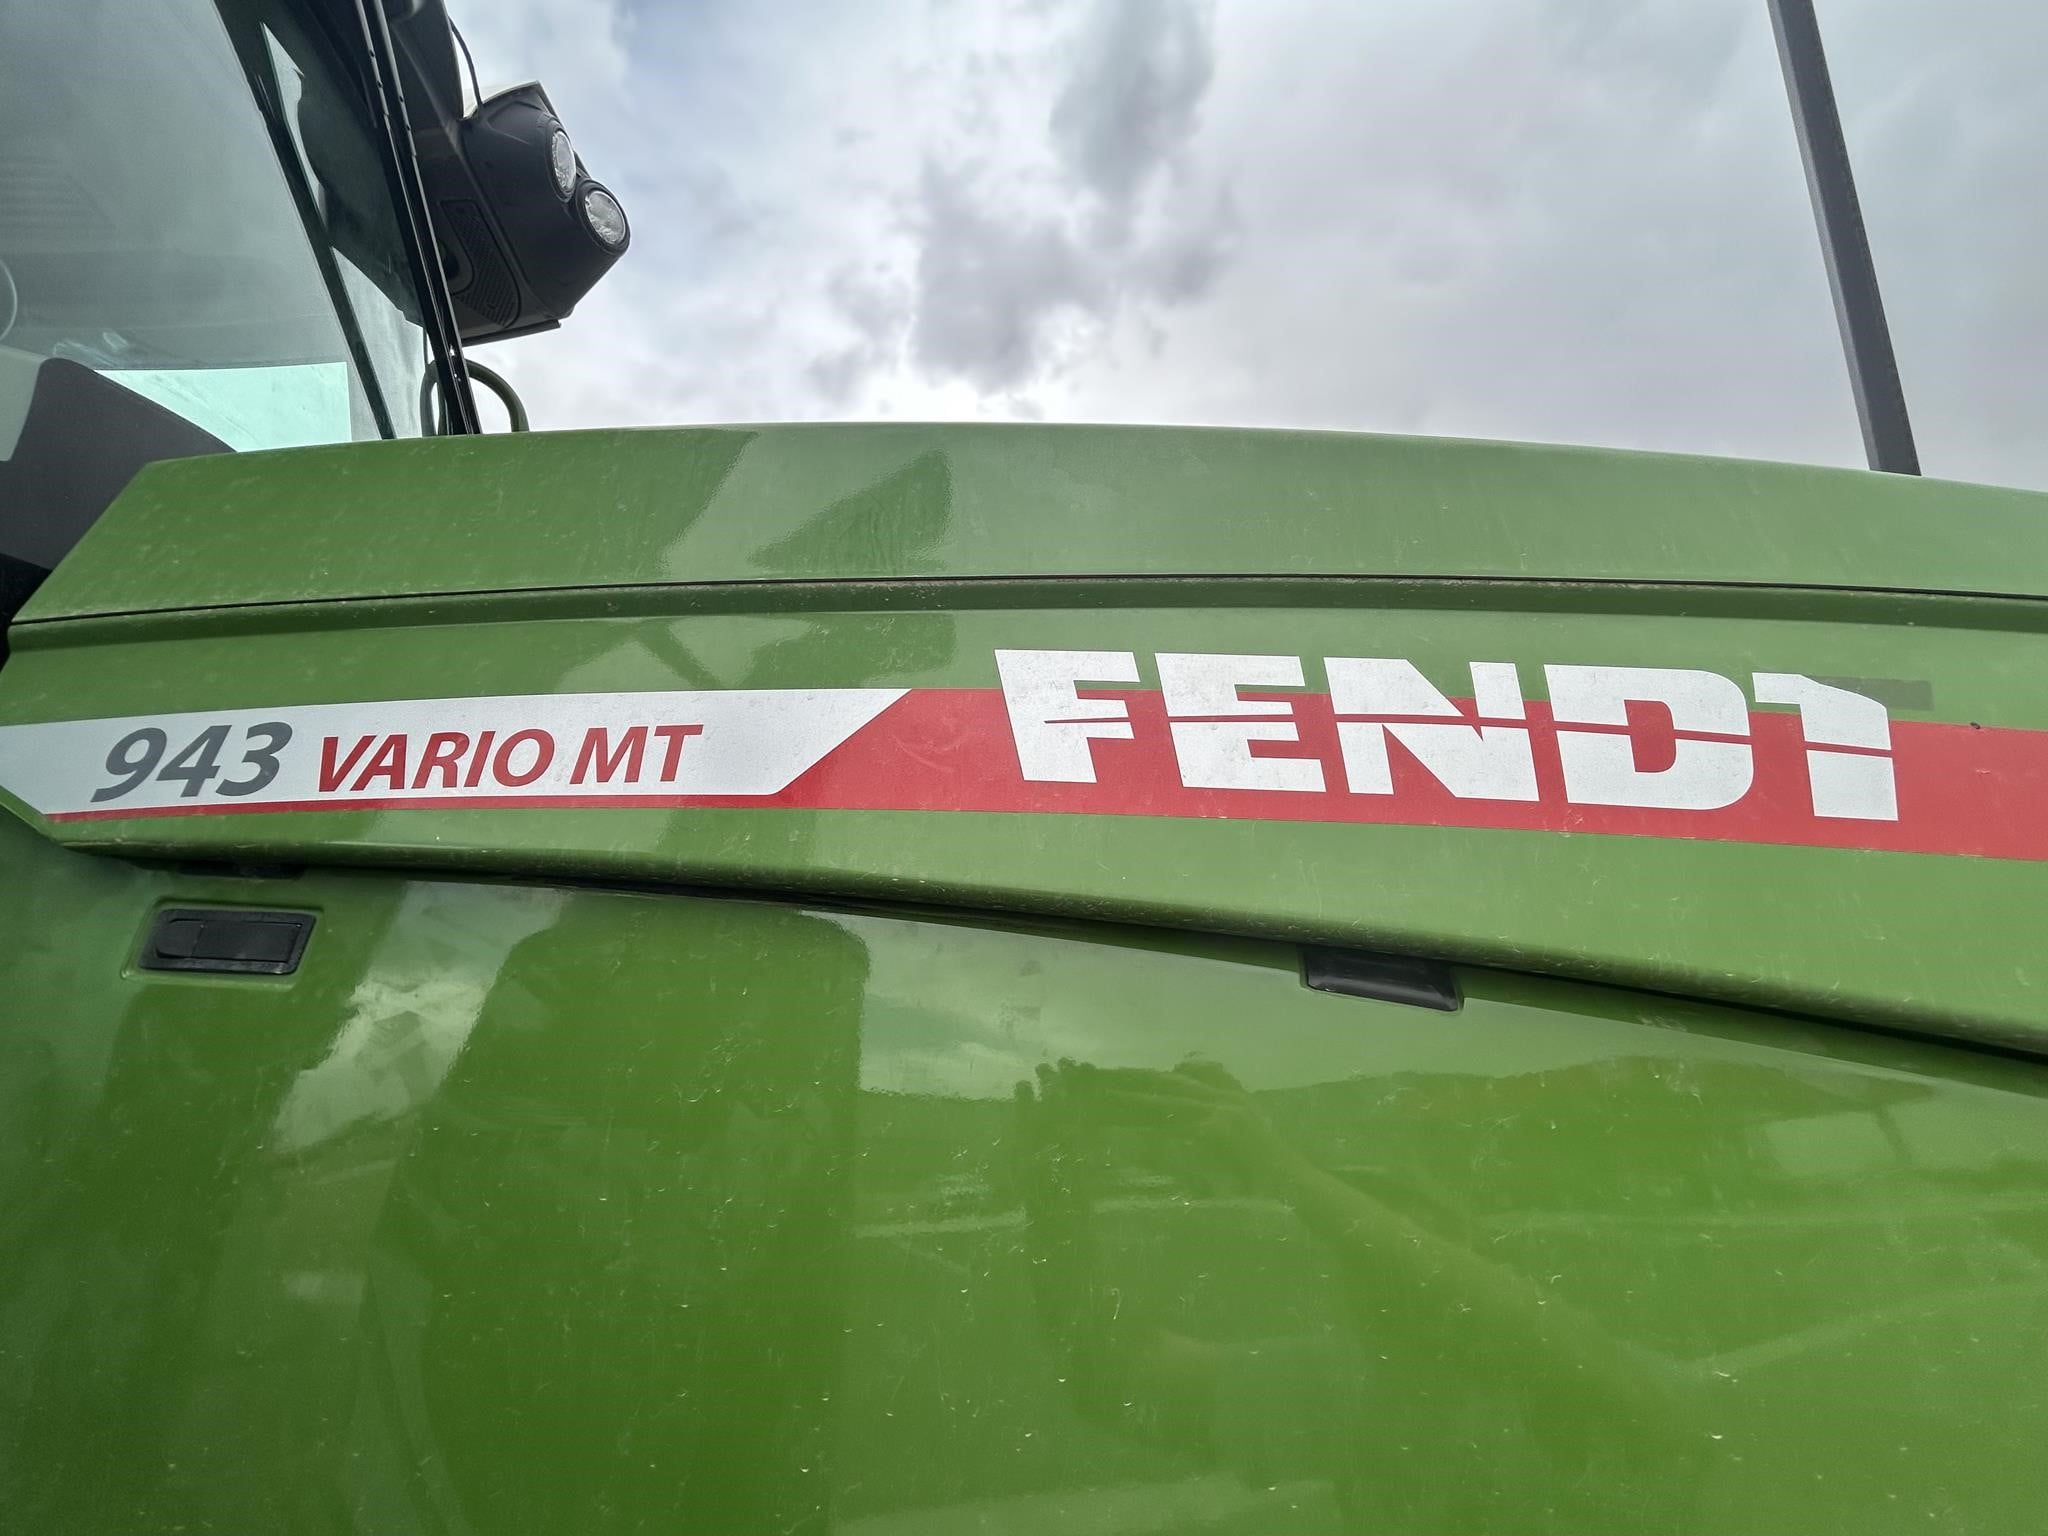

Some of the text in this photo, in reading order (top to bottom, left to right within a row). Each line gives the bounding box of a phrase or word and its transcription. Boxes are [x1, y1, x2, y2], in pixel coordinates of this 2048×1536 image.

[90, 721, 704, 804] 943 VARIO MT
